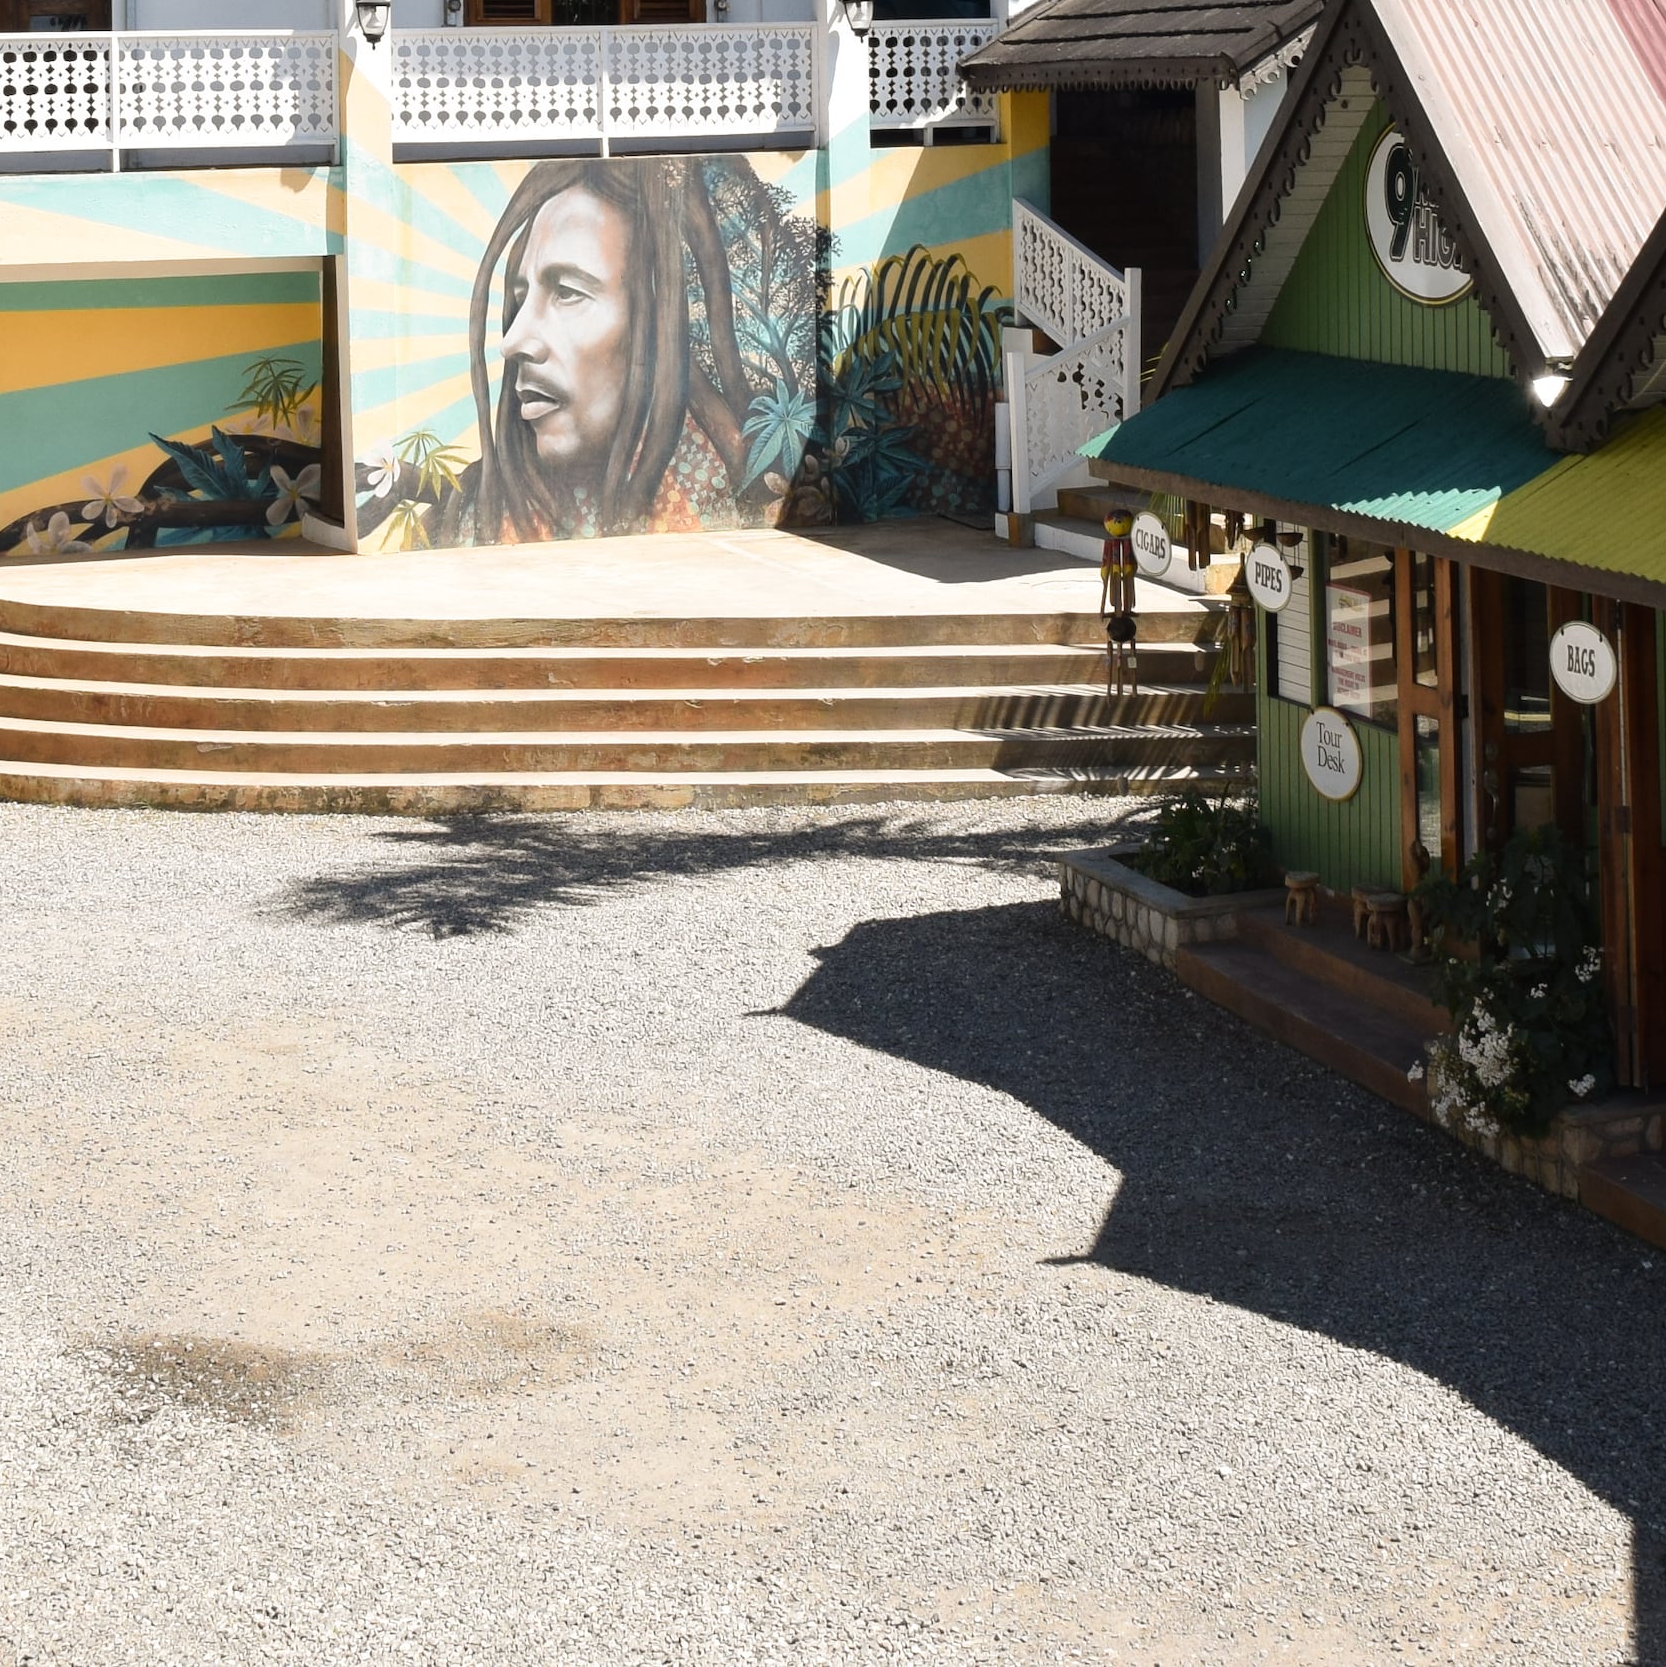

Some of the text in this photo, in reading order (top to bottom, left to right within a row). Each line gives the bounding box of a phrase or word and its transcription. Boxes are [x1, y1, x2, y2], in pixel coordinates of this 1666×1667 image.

[1135, 528, 1166, 561] CIGARS
[1255, 561, 1282, 593] PIPES
[1567, 644, 1596, 677] BAGS
[1316, 721, 1343, 748] Tour
[1317, 745, 1345, 774] Desk
